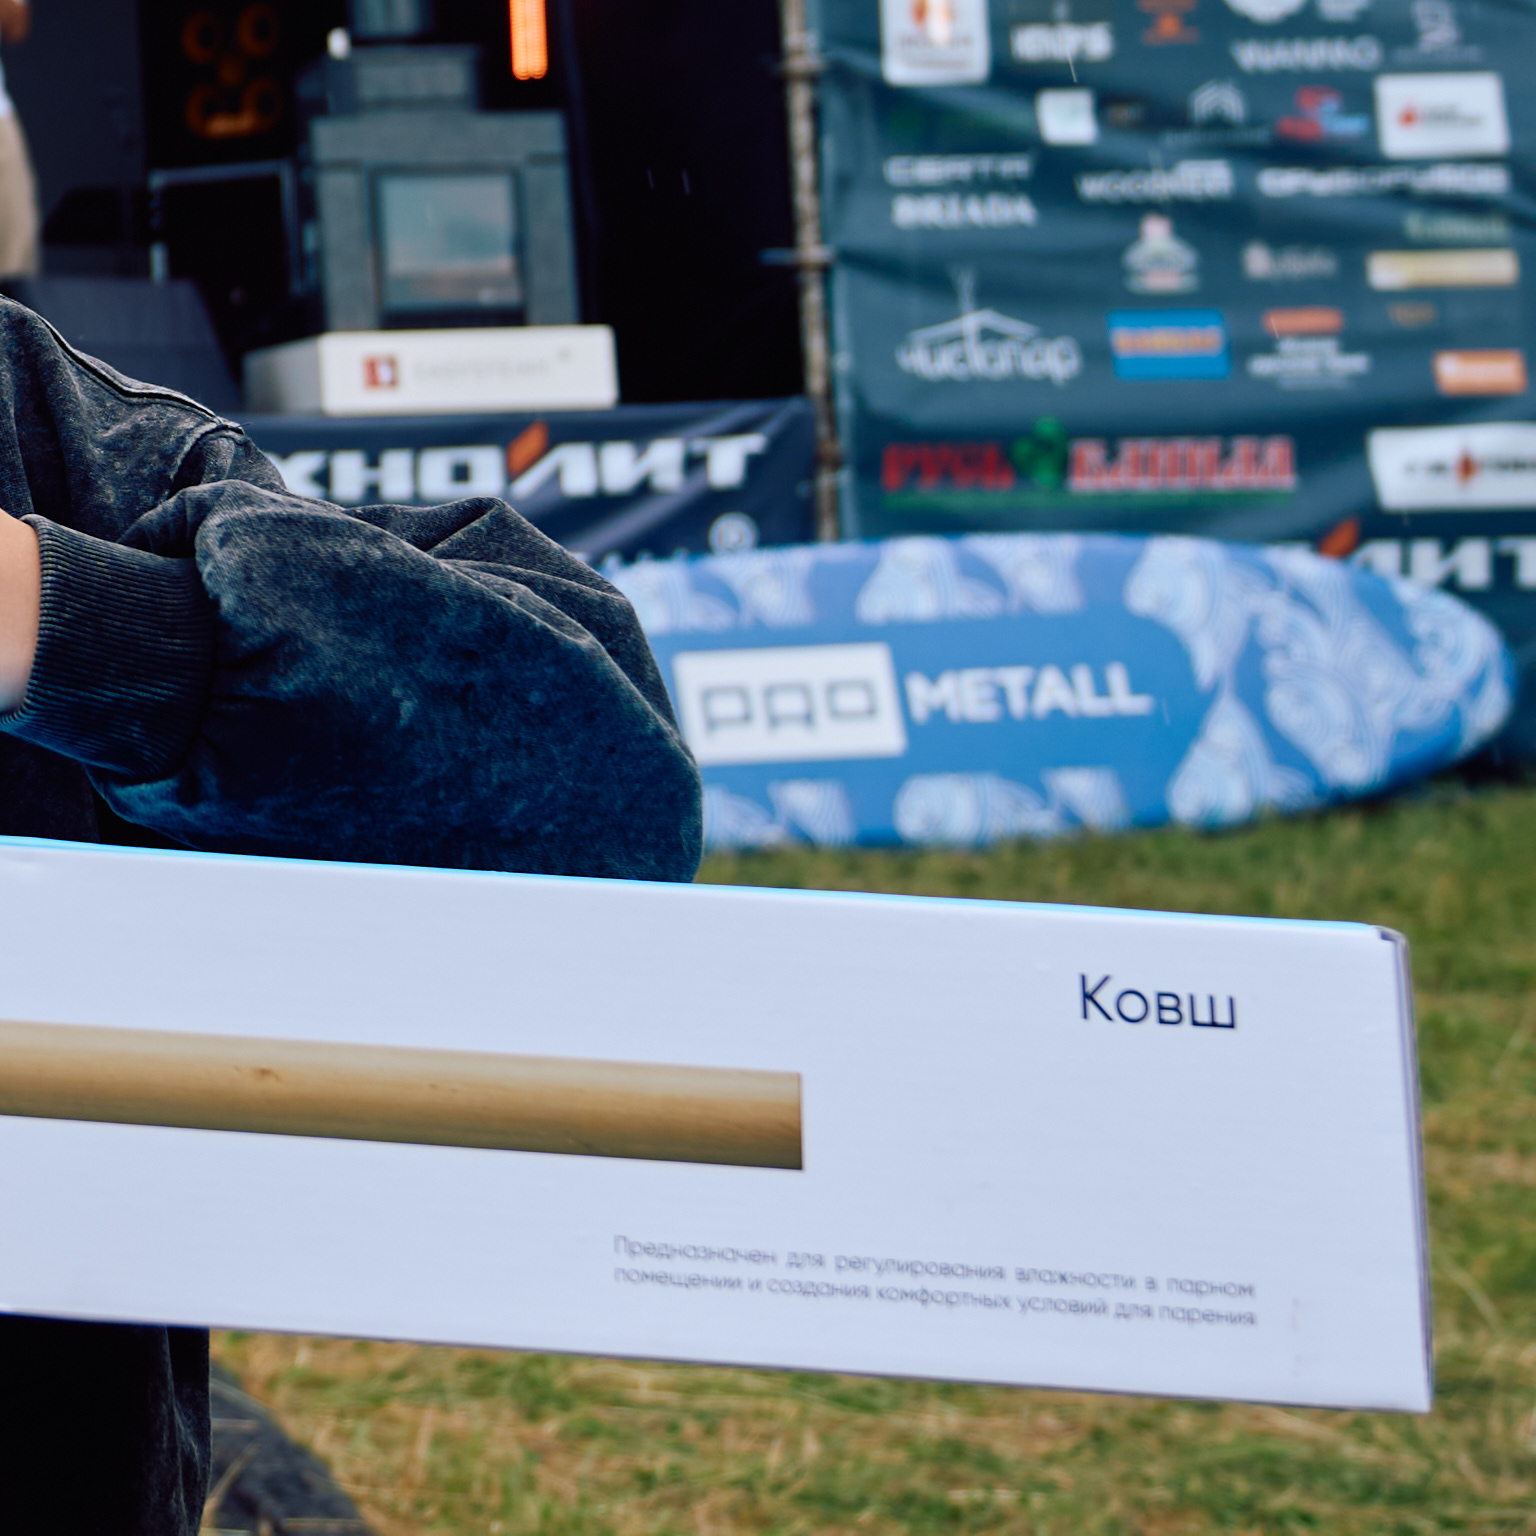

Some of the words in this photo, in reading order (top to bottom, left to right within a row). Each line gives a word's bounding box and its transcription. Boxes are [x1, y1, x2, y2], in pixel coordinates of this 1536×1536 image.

[266, 430, 768, 502] ХНОЛИТ
[905, 663, 1154, 725] METALL
[1080, 973, 1236, 1029] Ковш
[614, 1235, 777, 1264] Предназначен
[787, 1251, 826, 1270] для
[835, 1254, 1005, 1279] регулирования
[1015, 1266, 1136, 1291] влажности
[1145, 1276, 1157, 1291] в
[1167, 1278, 1255, 1300] парном
[614, 1267, 742, 1290] помещении
[748, 1277, 762, 1291] и
[766, 1277, 871, 1298] создания
[877, 1284, 1010, 1310] комфортных
[1018, 1295, 1108, 1315] условий
[1115, 1302, 1153, 1321] для
[1159, 1305, 1256, 1328] парения
